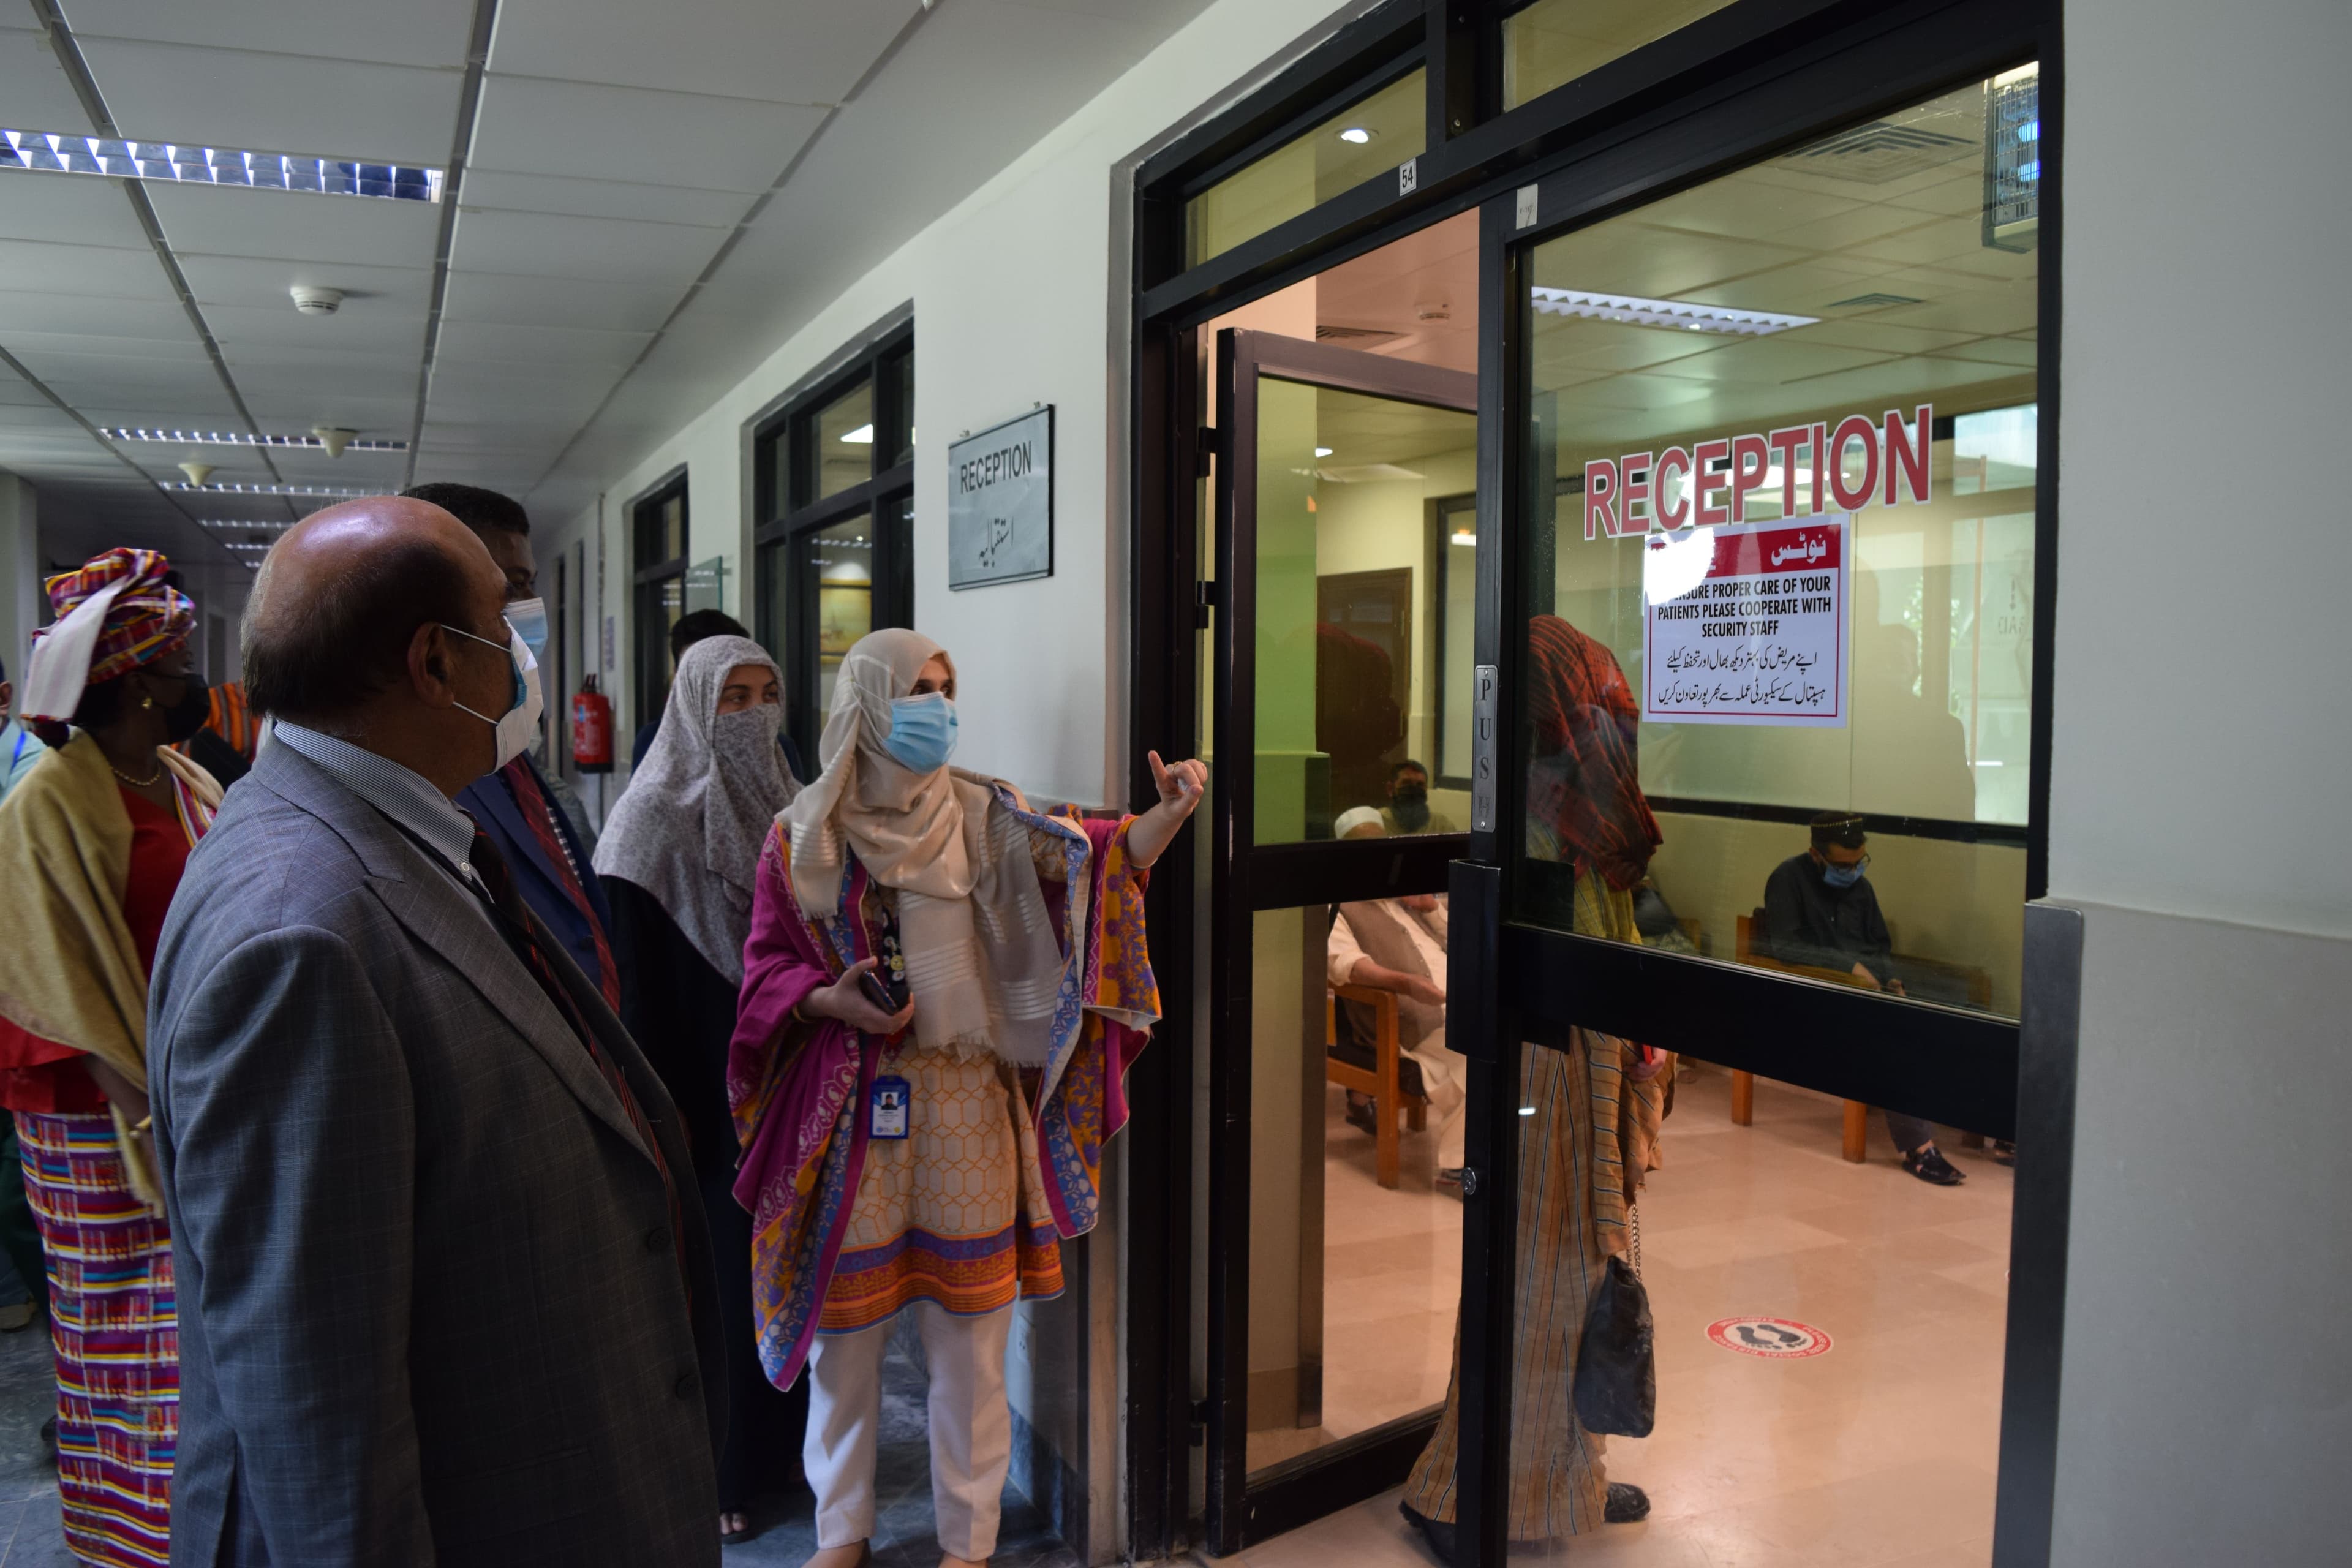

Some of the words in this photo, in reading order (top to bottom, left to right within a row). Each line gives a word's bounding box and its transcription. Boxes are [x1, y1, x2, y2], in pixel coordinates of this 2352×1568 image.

[1402, 166, 1413, 189] 54
[960, 440, 1032, 494] RECEPTION
[1584, 403, 1932, 540] RECEPTION
[1771, 531, 1826, 567] نوٹس
[1713, 581, 1751, 598] PROPER
[1754, 579, 1779, 596] CARE
[1783, 578, 1797, 593] OF
[1800, 576, 1831, 592] YOUR
[1658, 604, 1700, 620] PATIENTS
[1703, 602, 1735, 618] PLEASE
[1739, 600, 1798, 616] COOPERATE
[1801, 597, 1831, 614] WITH
[1702, 621, 1747, 638] SECURITY
[1750, 620, 1779, 636] STAFF
[1683, 650, 1700, 668] تحفظ
[1697, 654, 1709, 668] اور
[1742, 649, 1760, 671] بہتر
[1760, 644, 1773, 670] کی
[1769, 647, 1795, 671] مریض
[1796, 651, 1817, 675] اپنے
[1659, 680, 1680, 705] کریں
[1676, 684, 1699, 703] تعاون
[1719, 692, 1735, 701] سے
[1735, 684, 1751, 701] عملہ
[1778, 681, 1793, 701] کے
[1795, 681, 1825, 706] ہسپتال
[1479, 678, 1491, 819] PUSH
